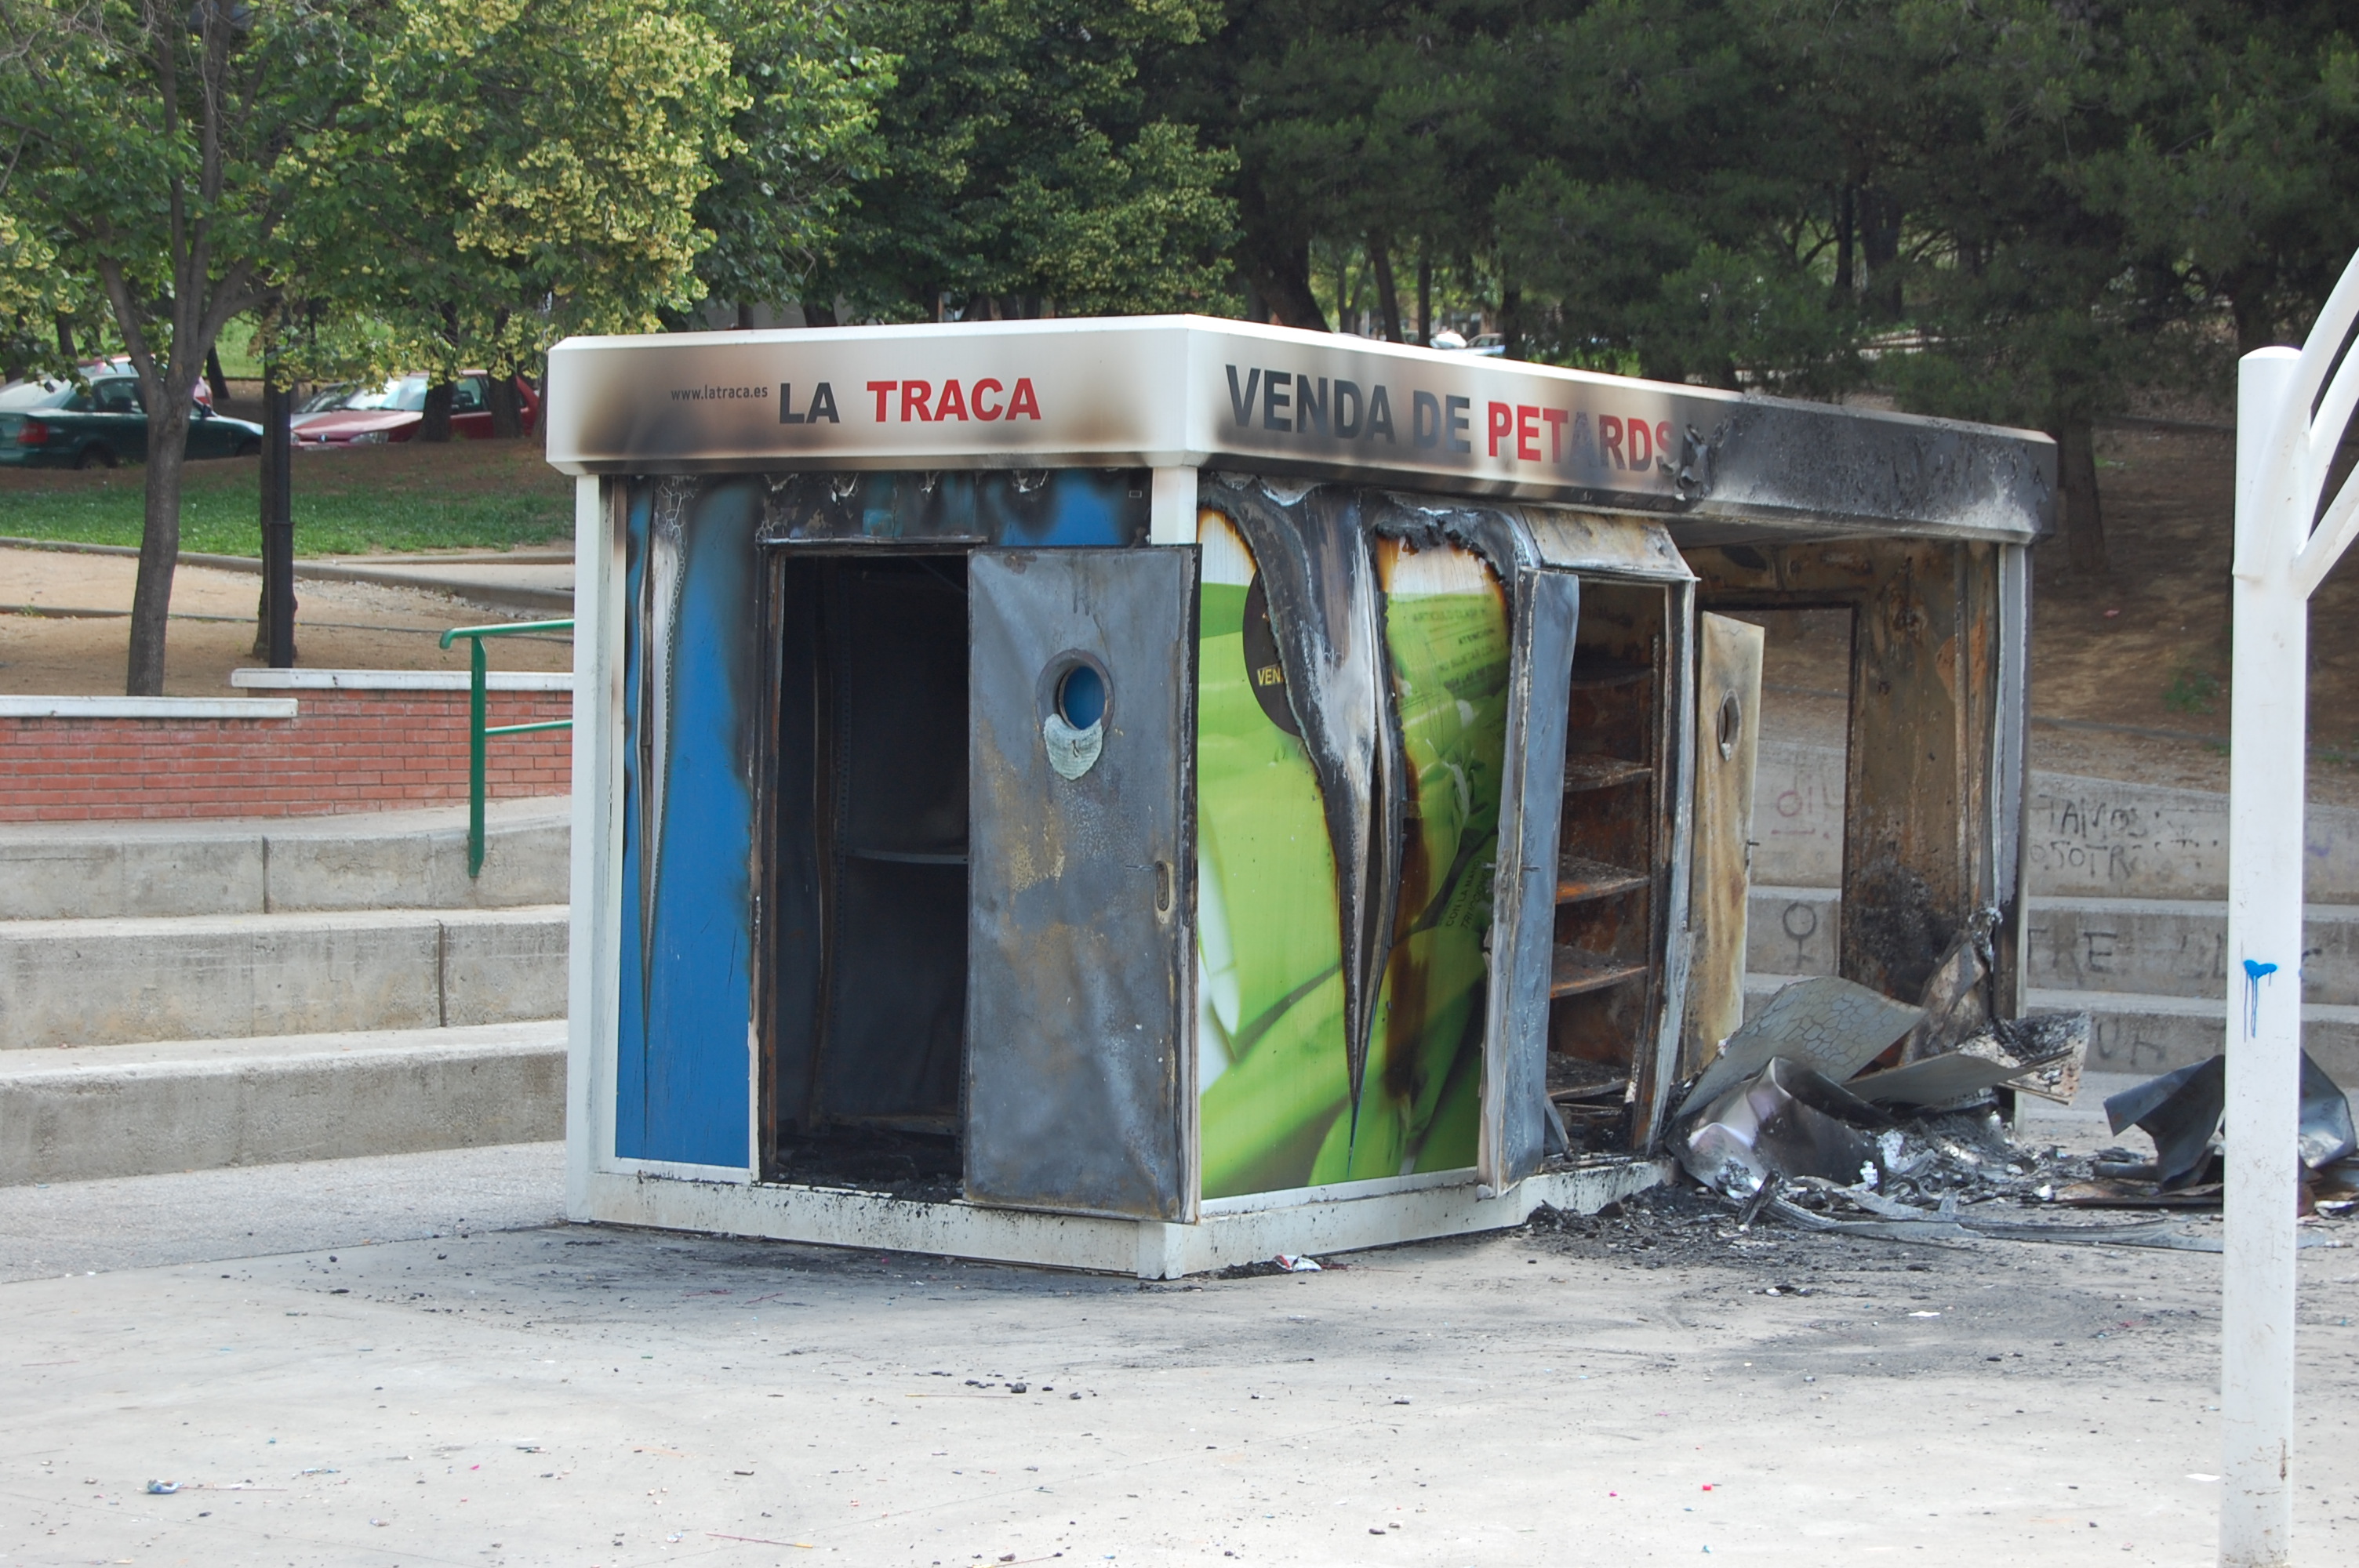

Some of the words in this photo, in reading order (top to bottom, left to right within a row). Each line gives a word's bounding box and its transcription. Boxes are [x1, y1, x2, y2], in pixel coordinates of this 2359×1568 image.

[671, 383, 769, 401] www.latraca.es
[779, 382, 841, 424] LA
[867, 377, 1042, 423] TRACA
[1225, 364, 1397, 445] VENDA
[1412, 389, 1471, 454] DE
[1488, 401, 1677, 472] PETARDS
[1257, 666, 1284, 687] VEN
